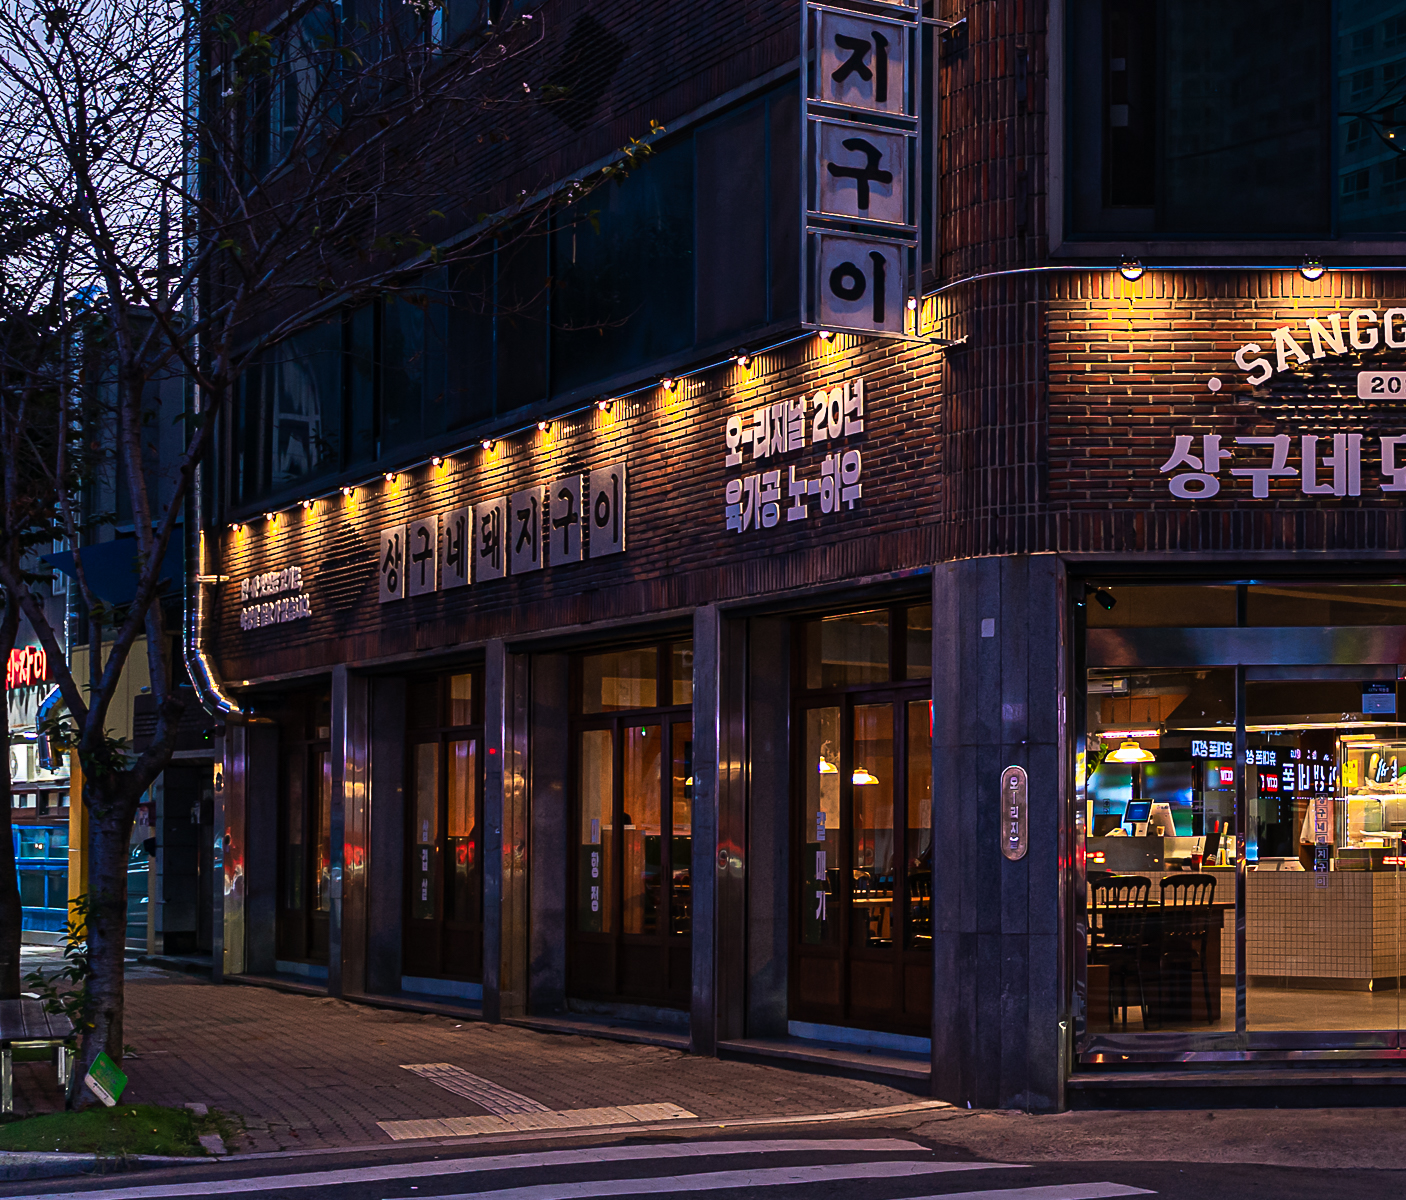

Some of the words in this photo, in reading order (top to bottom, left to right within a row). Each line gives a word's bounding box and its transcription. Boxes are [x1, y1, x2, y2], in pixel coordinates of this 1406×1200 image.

[812, 378, 865, 442] 20년
[1160, 432, 1362, 500] 상구네
[725, 469, 781, 534] 육가공
